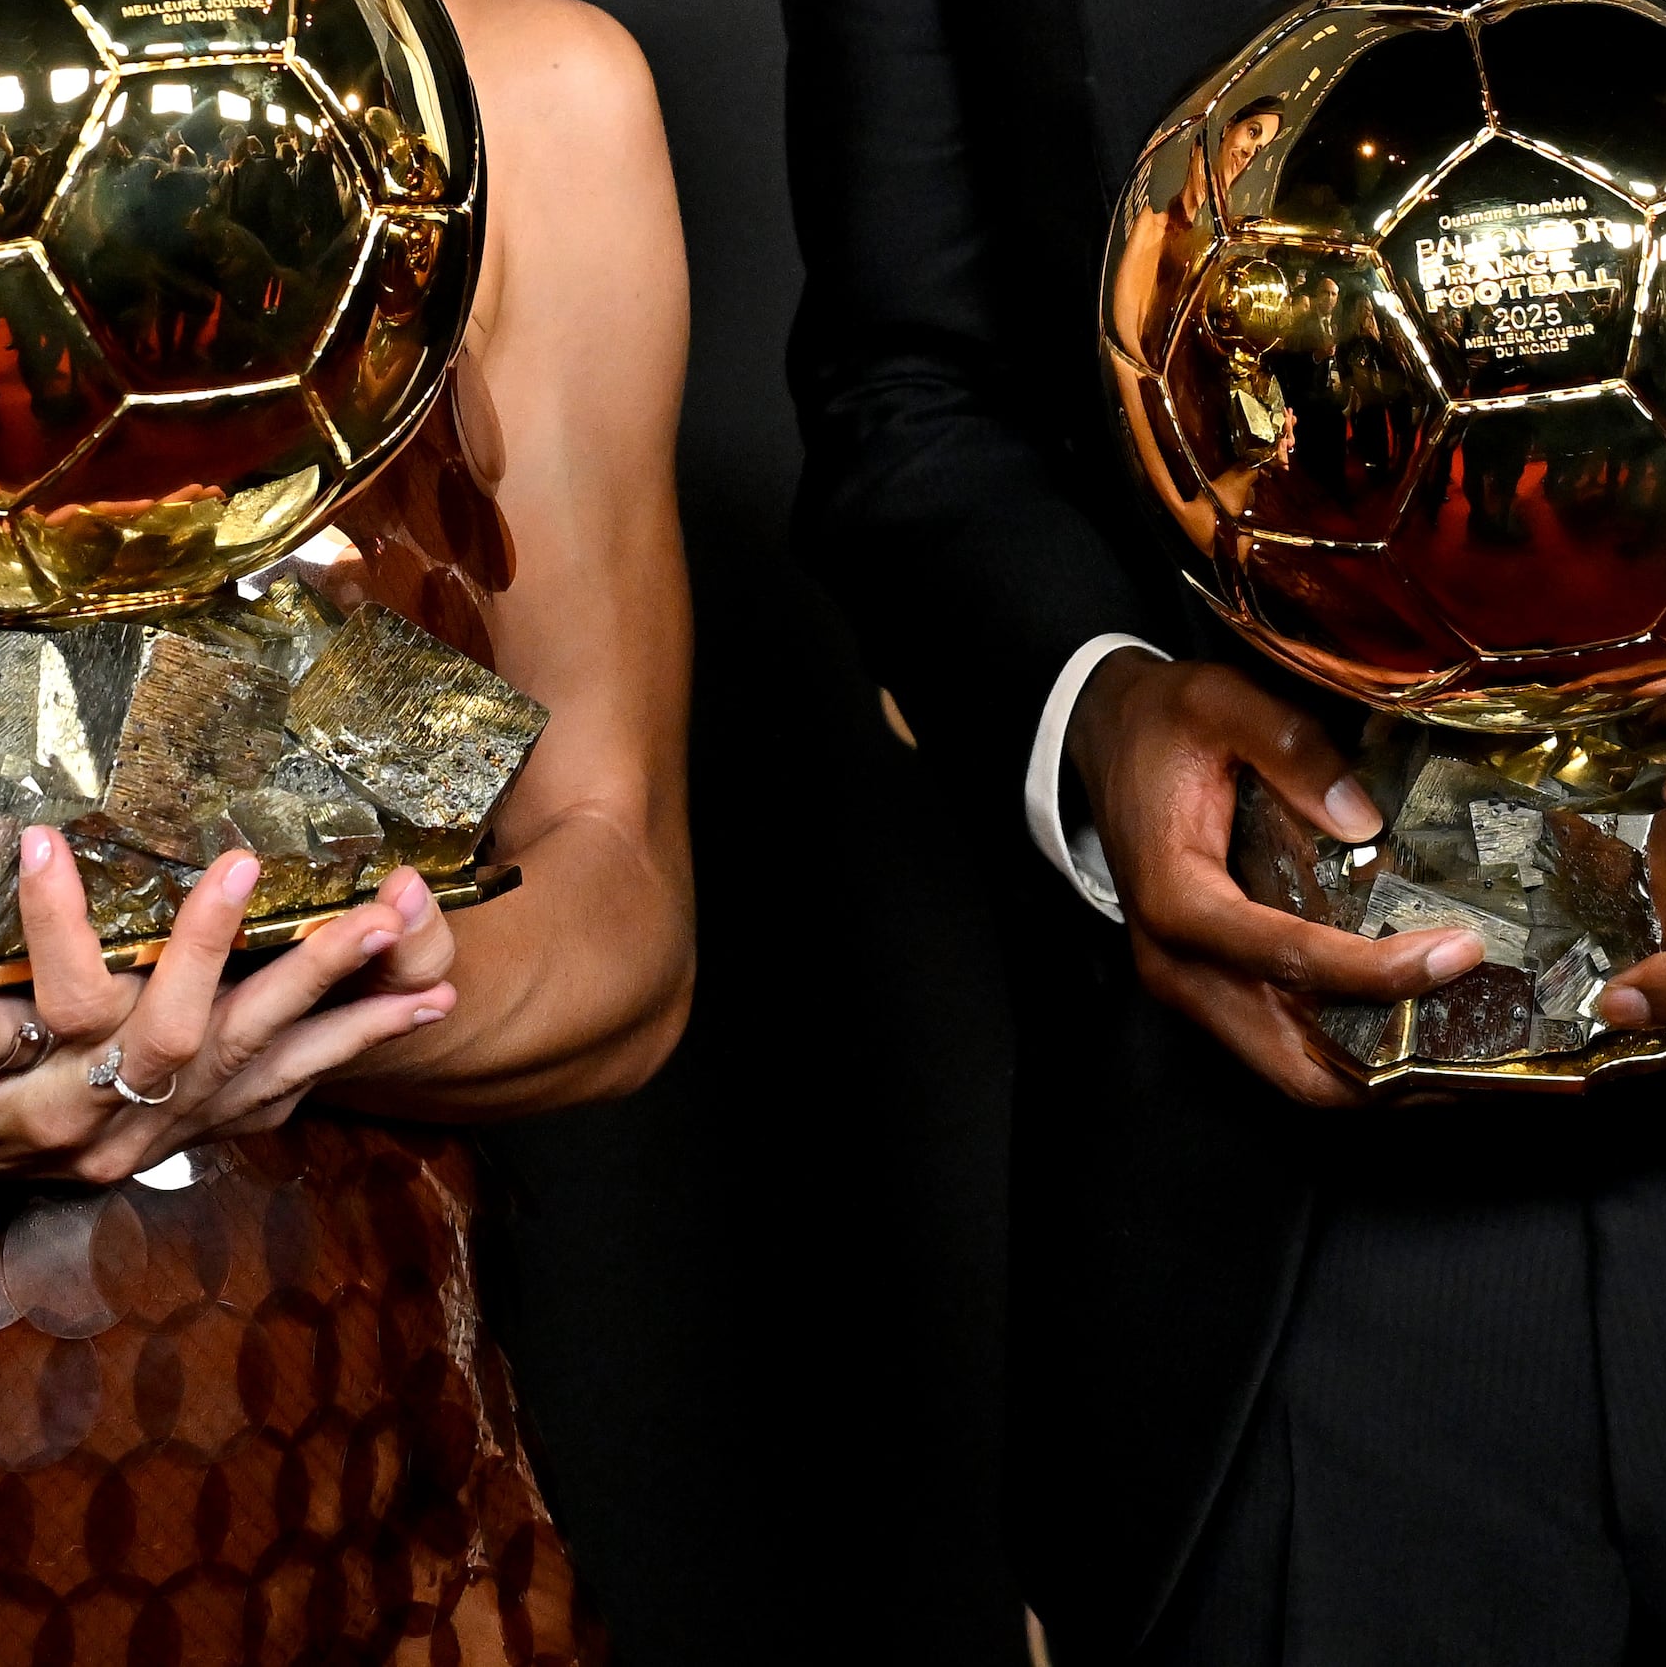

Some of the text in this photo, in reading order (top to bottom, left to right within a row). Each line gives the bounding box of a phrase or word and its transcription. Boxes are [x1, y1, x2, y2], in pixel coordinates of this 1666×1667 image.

[161, 8, 238, 26] DU MONDE
[1438, 207, 1513, 230] Ousmane
[1425, 268, 1622, 314] FOOTBALL
[1492, 302, 1563, 333] 2025
[1464, 323, 1595, 350] MEILLEUR JOUEUR
[1494, 338, 1569, 359] DU MONDE
